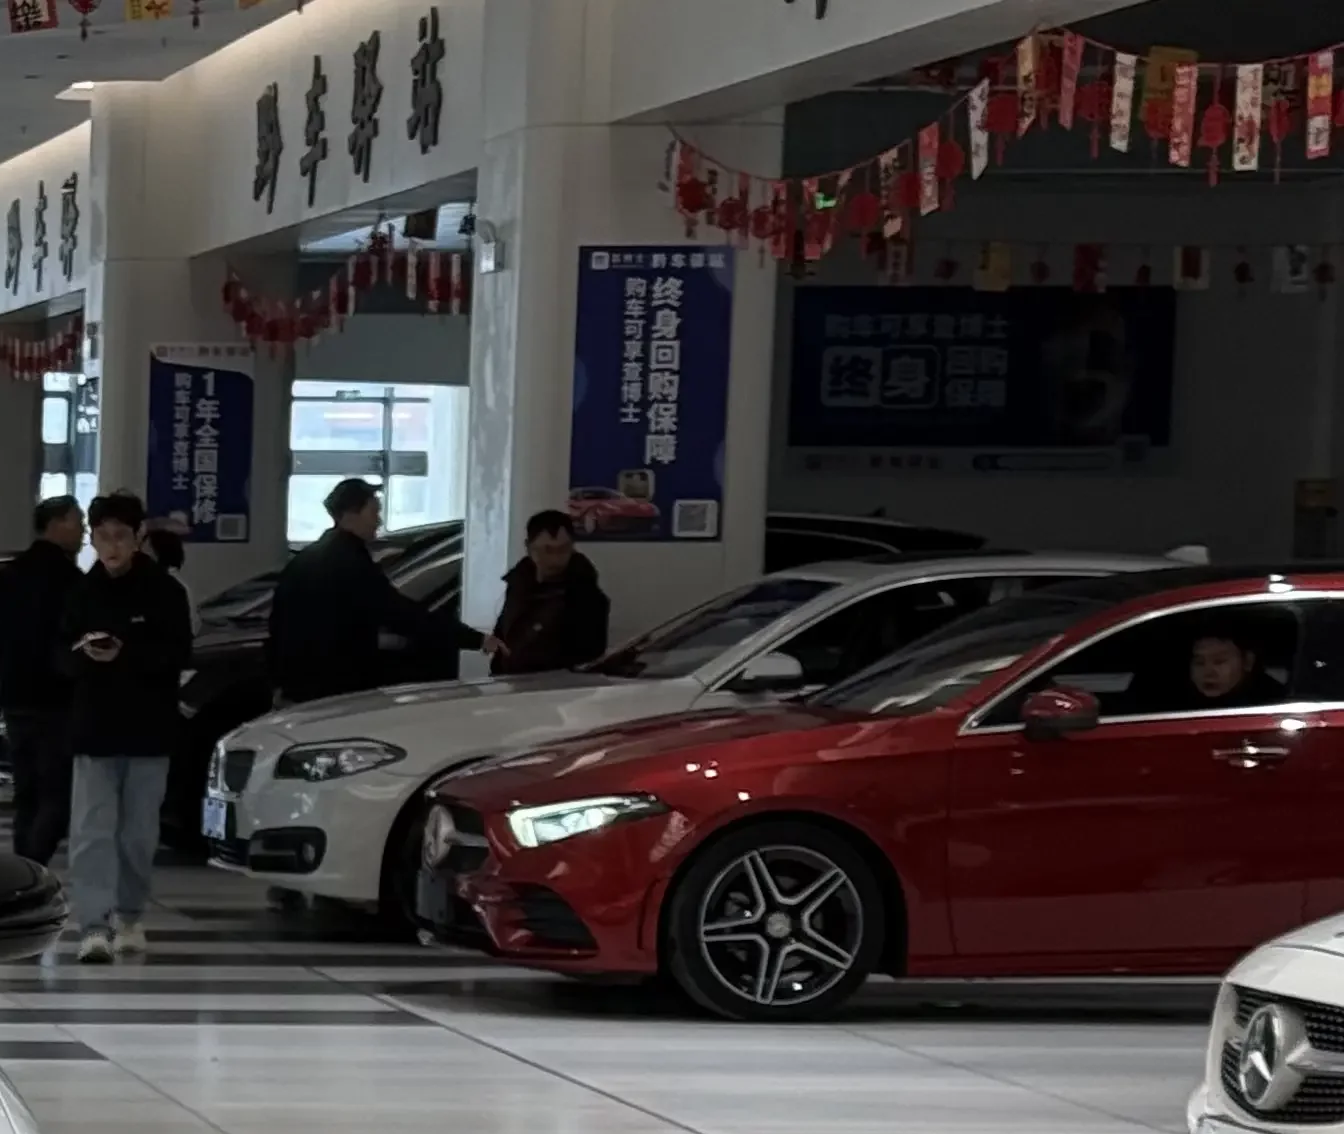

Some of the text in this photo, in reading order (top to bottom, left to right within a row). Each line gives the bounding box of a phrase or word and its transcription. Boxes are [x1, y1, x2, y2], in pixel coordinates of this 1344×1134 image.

[192, 371, 222, 525] 1年全国保修
[644, 275, 684, 465] 终身回购保障
